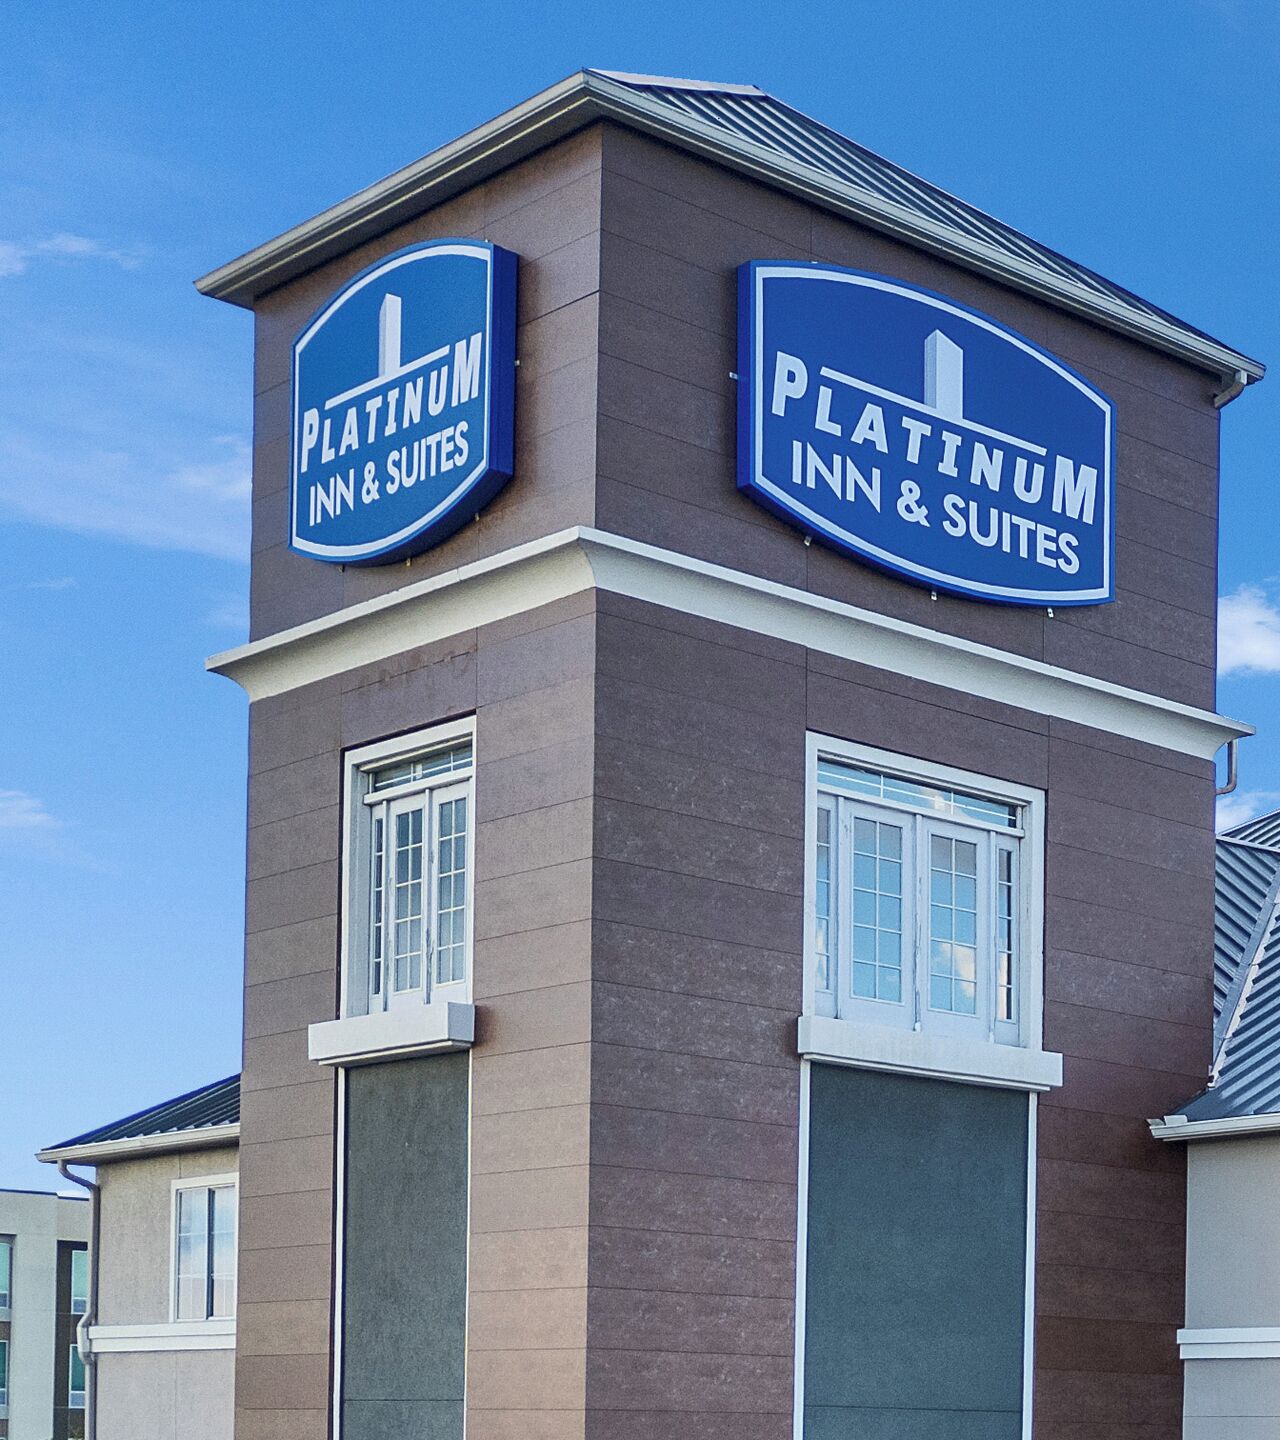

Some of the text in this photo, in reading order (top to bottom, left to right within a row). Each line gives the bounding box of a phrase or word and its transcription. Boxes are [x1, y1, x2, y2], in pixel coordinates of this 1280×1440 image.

[301, 332, 482, 473] PLATINUM
[772, 351, 1097, 525] PLATINUM
[309, 421, 469, 526] INN & SUITES
[792, 440, 1080, 575] INN & SUITES
